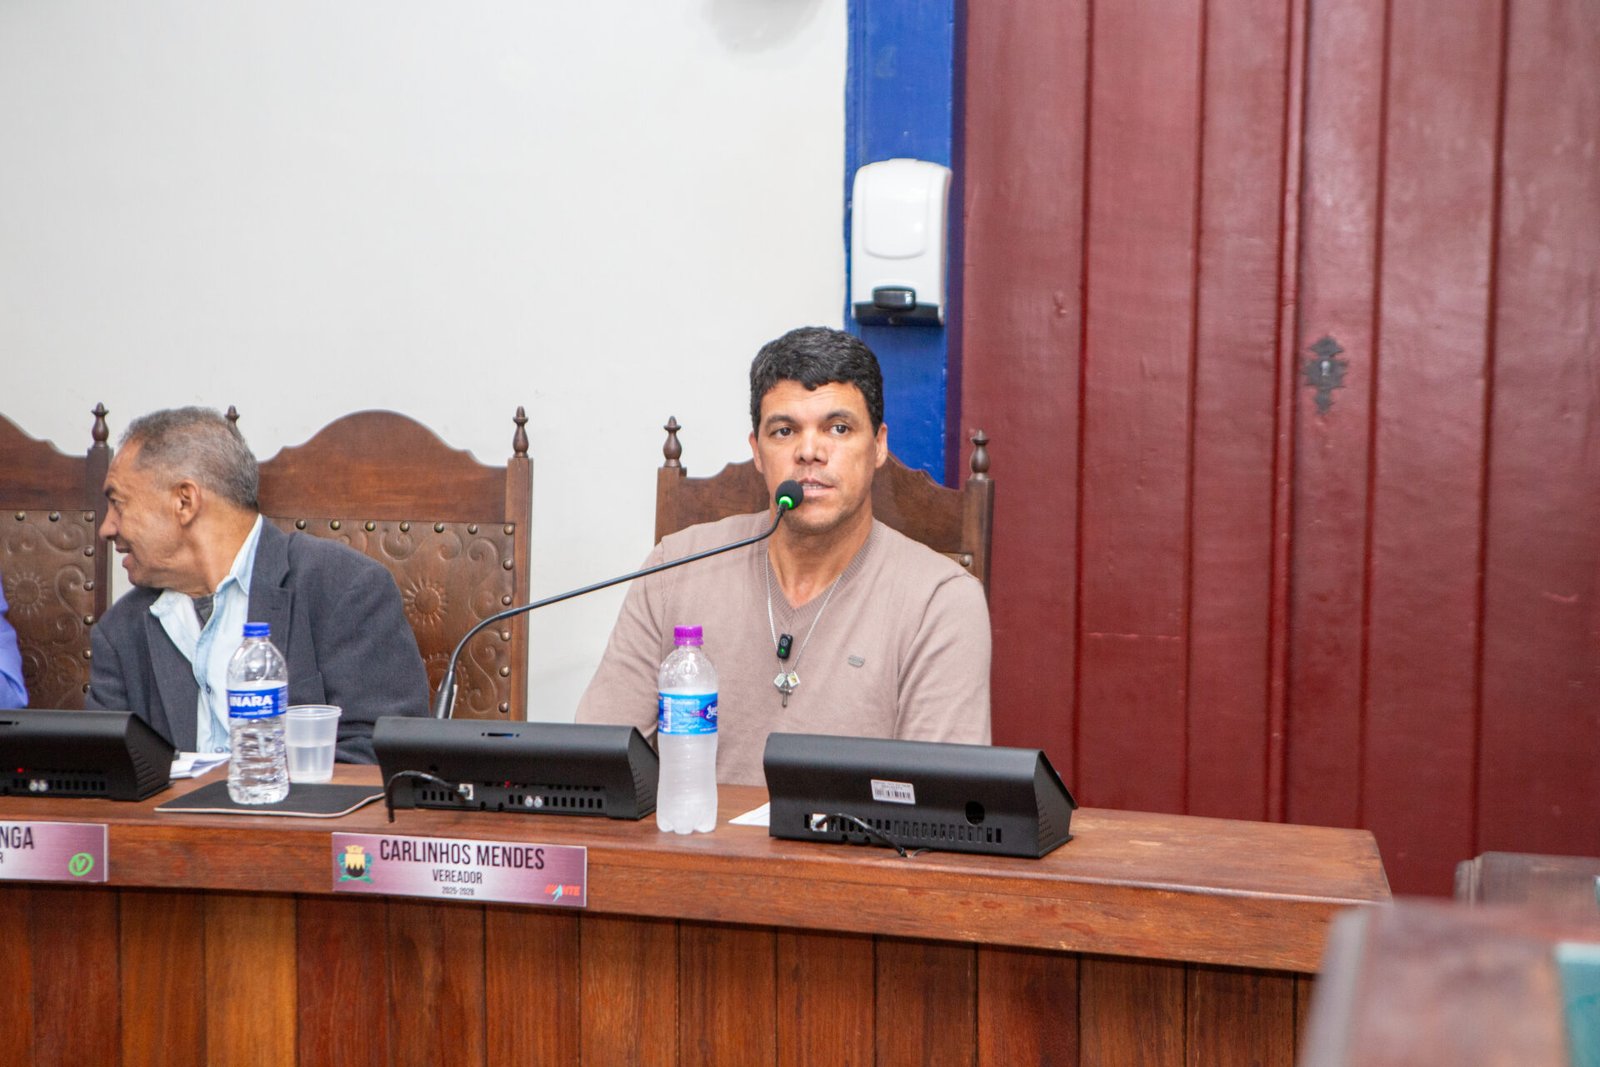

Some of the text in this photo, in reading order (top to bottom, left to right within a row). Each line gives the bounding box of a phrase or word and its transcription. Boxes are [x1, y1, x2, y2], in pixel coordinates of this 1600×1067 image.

[379, 839, 545, 870] CARLINHOS MENDES
[432, 869, 483, 884] VEREADOR
